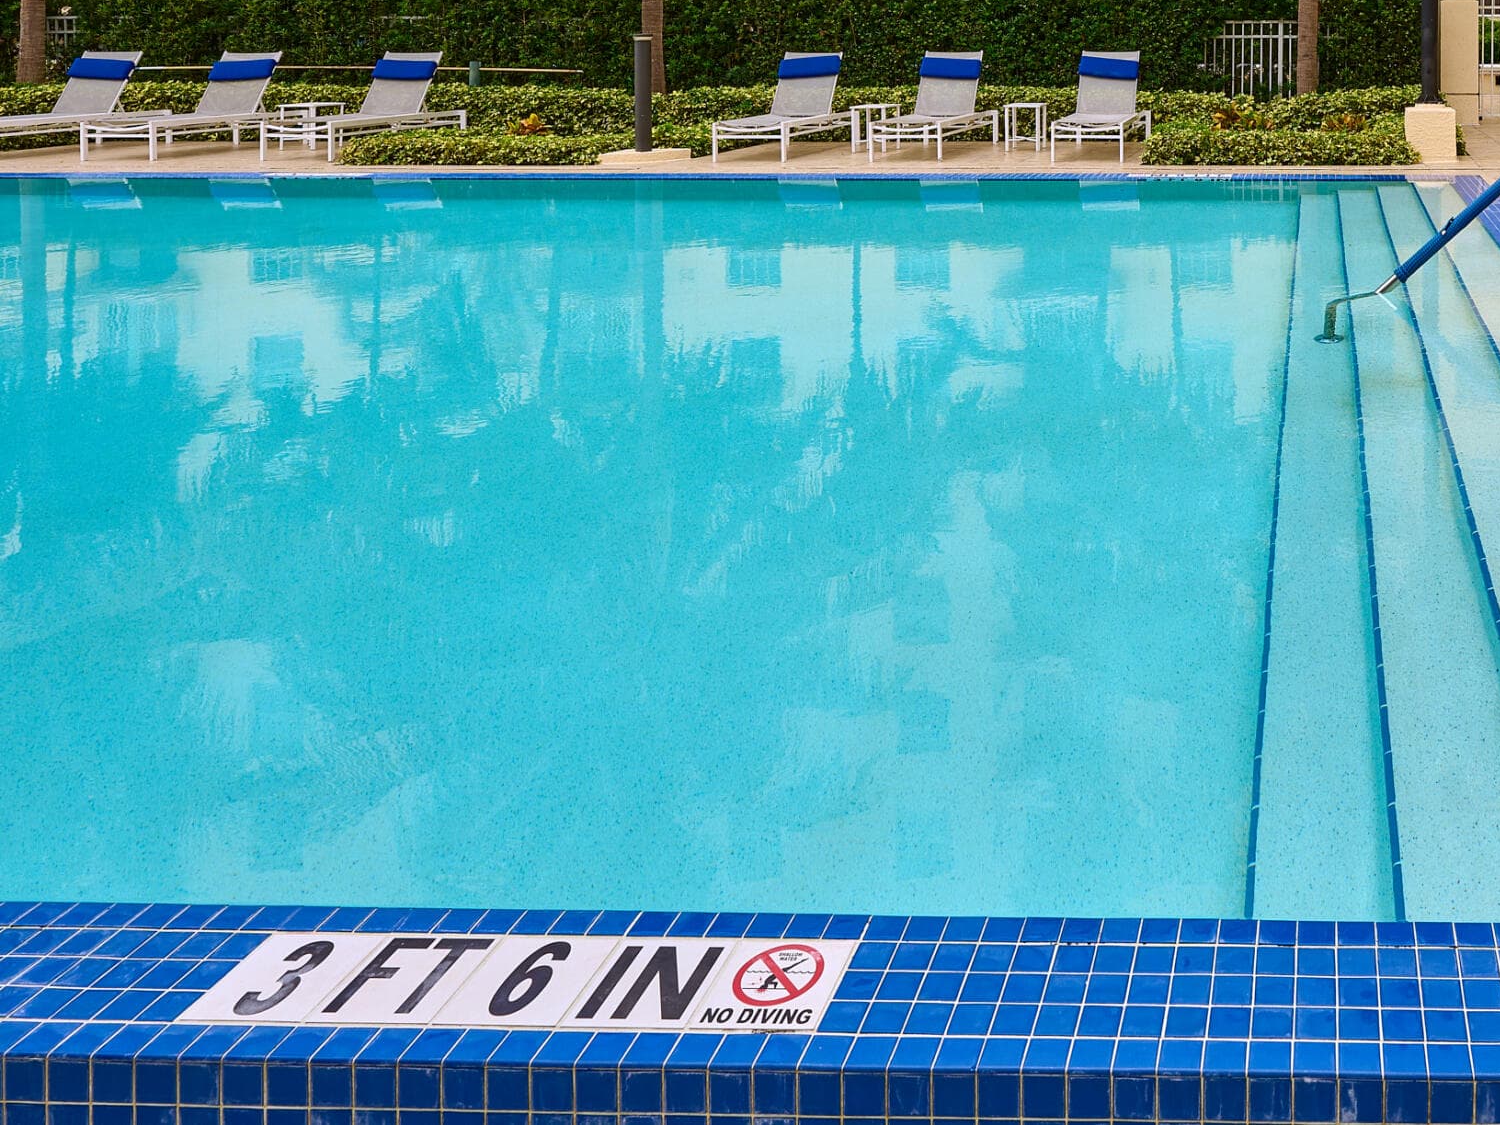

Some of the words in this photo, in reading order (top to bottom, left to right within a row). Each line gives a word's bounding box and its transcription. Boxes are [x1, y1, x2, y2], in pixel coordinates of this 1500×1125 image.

[233, 940, 335, 1016] 3
[321, 938, 496, 1014] FT
[488, 941, 572, 1017] 6
[575, 946, 726, 1020] IN
[699, 1007, 734, 1024] NO
[736, 1007, 813, 1025] DIVING
